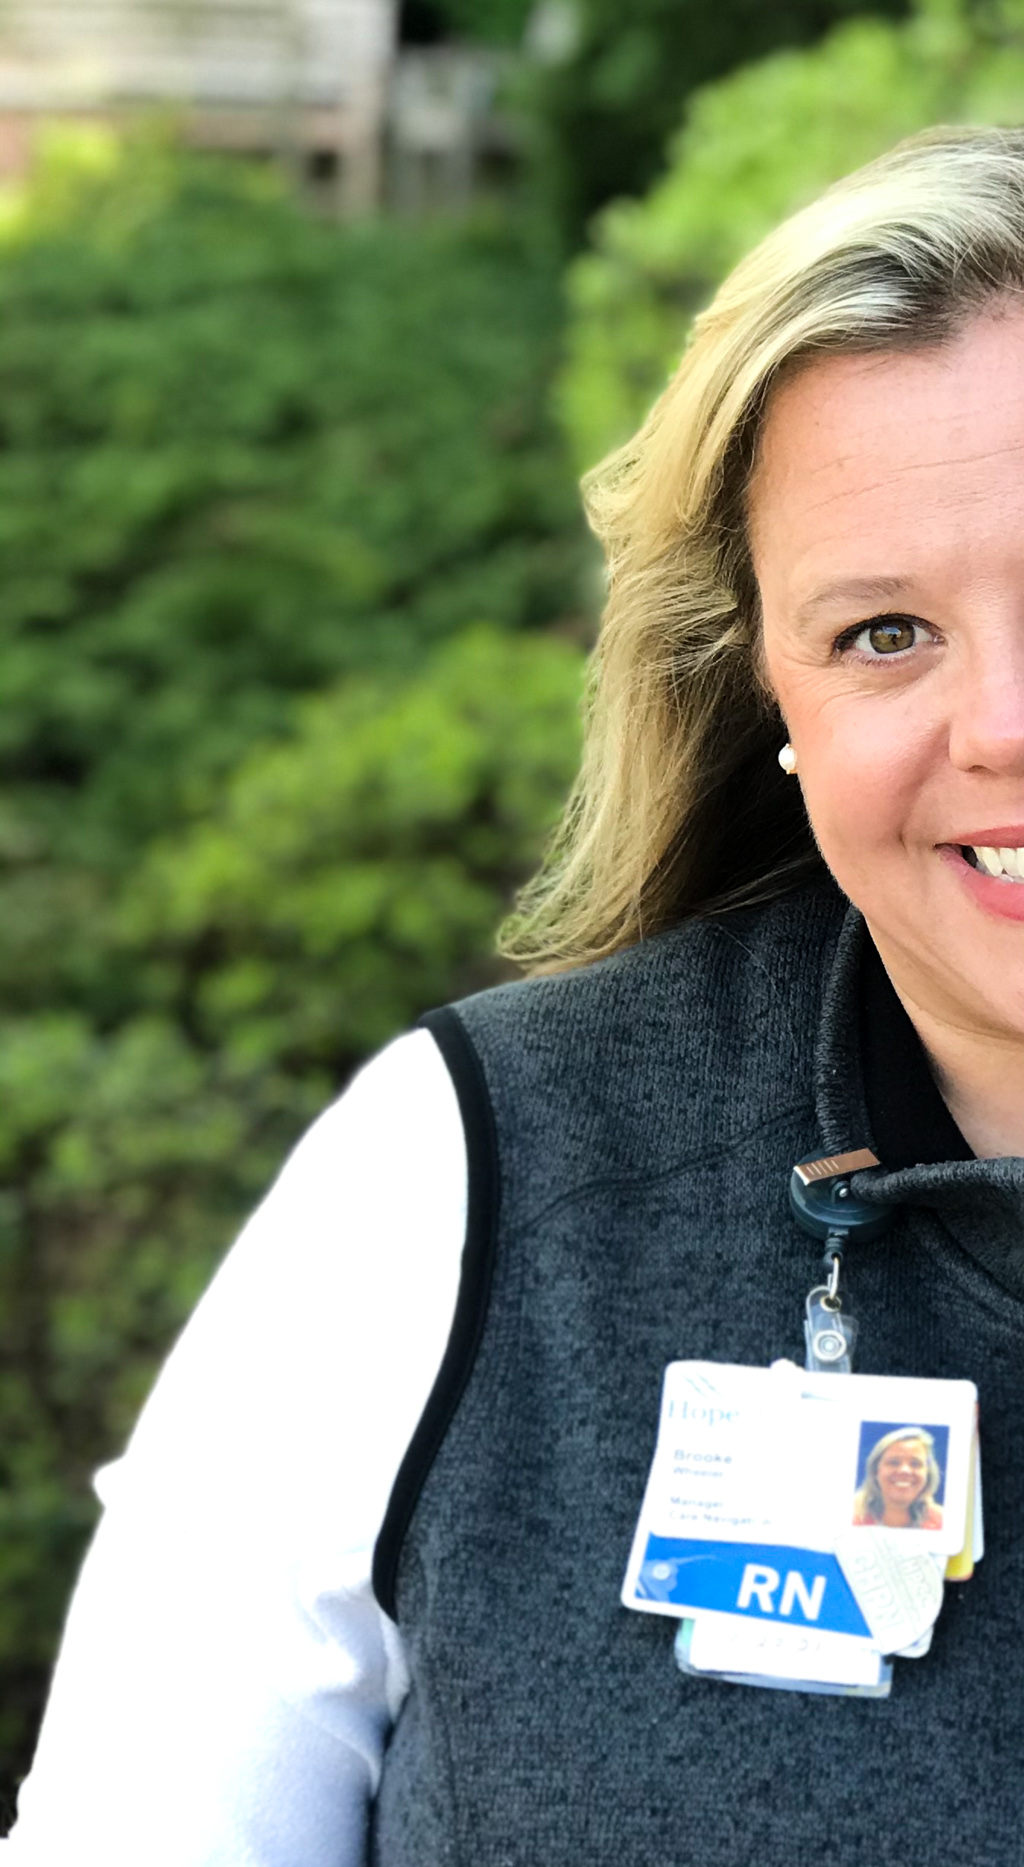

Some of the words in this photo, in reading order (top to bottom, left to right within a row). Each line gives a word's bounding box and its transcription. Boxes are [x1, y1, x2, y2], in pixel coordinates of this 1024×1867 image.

[674, 1448, 732, 1465] Brooke
[669, 1495, 724, 1510] Manager
[703, 1512, 772, 1527] Navigatin
[737, 1563, 827, 1621] RN
